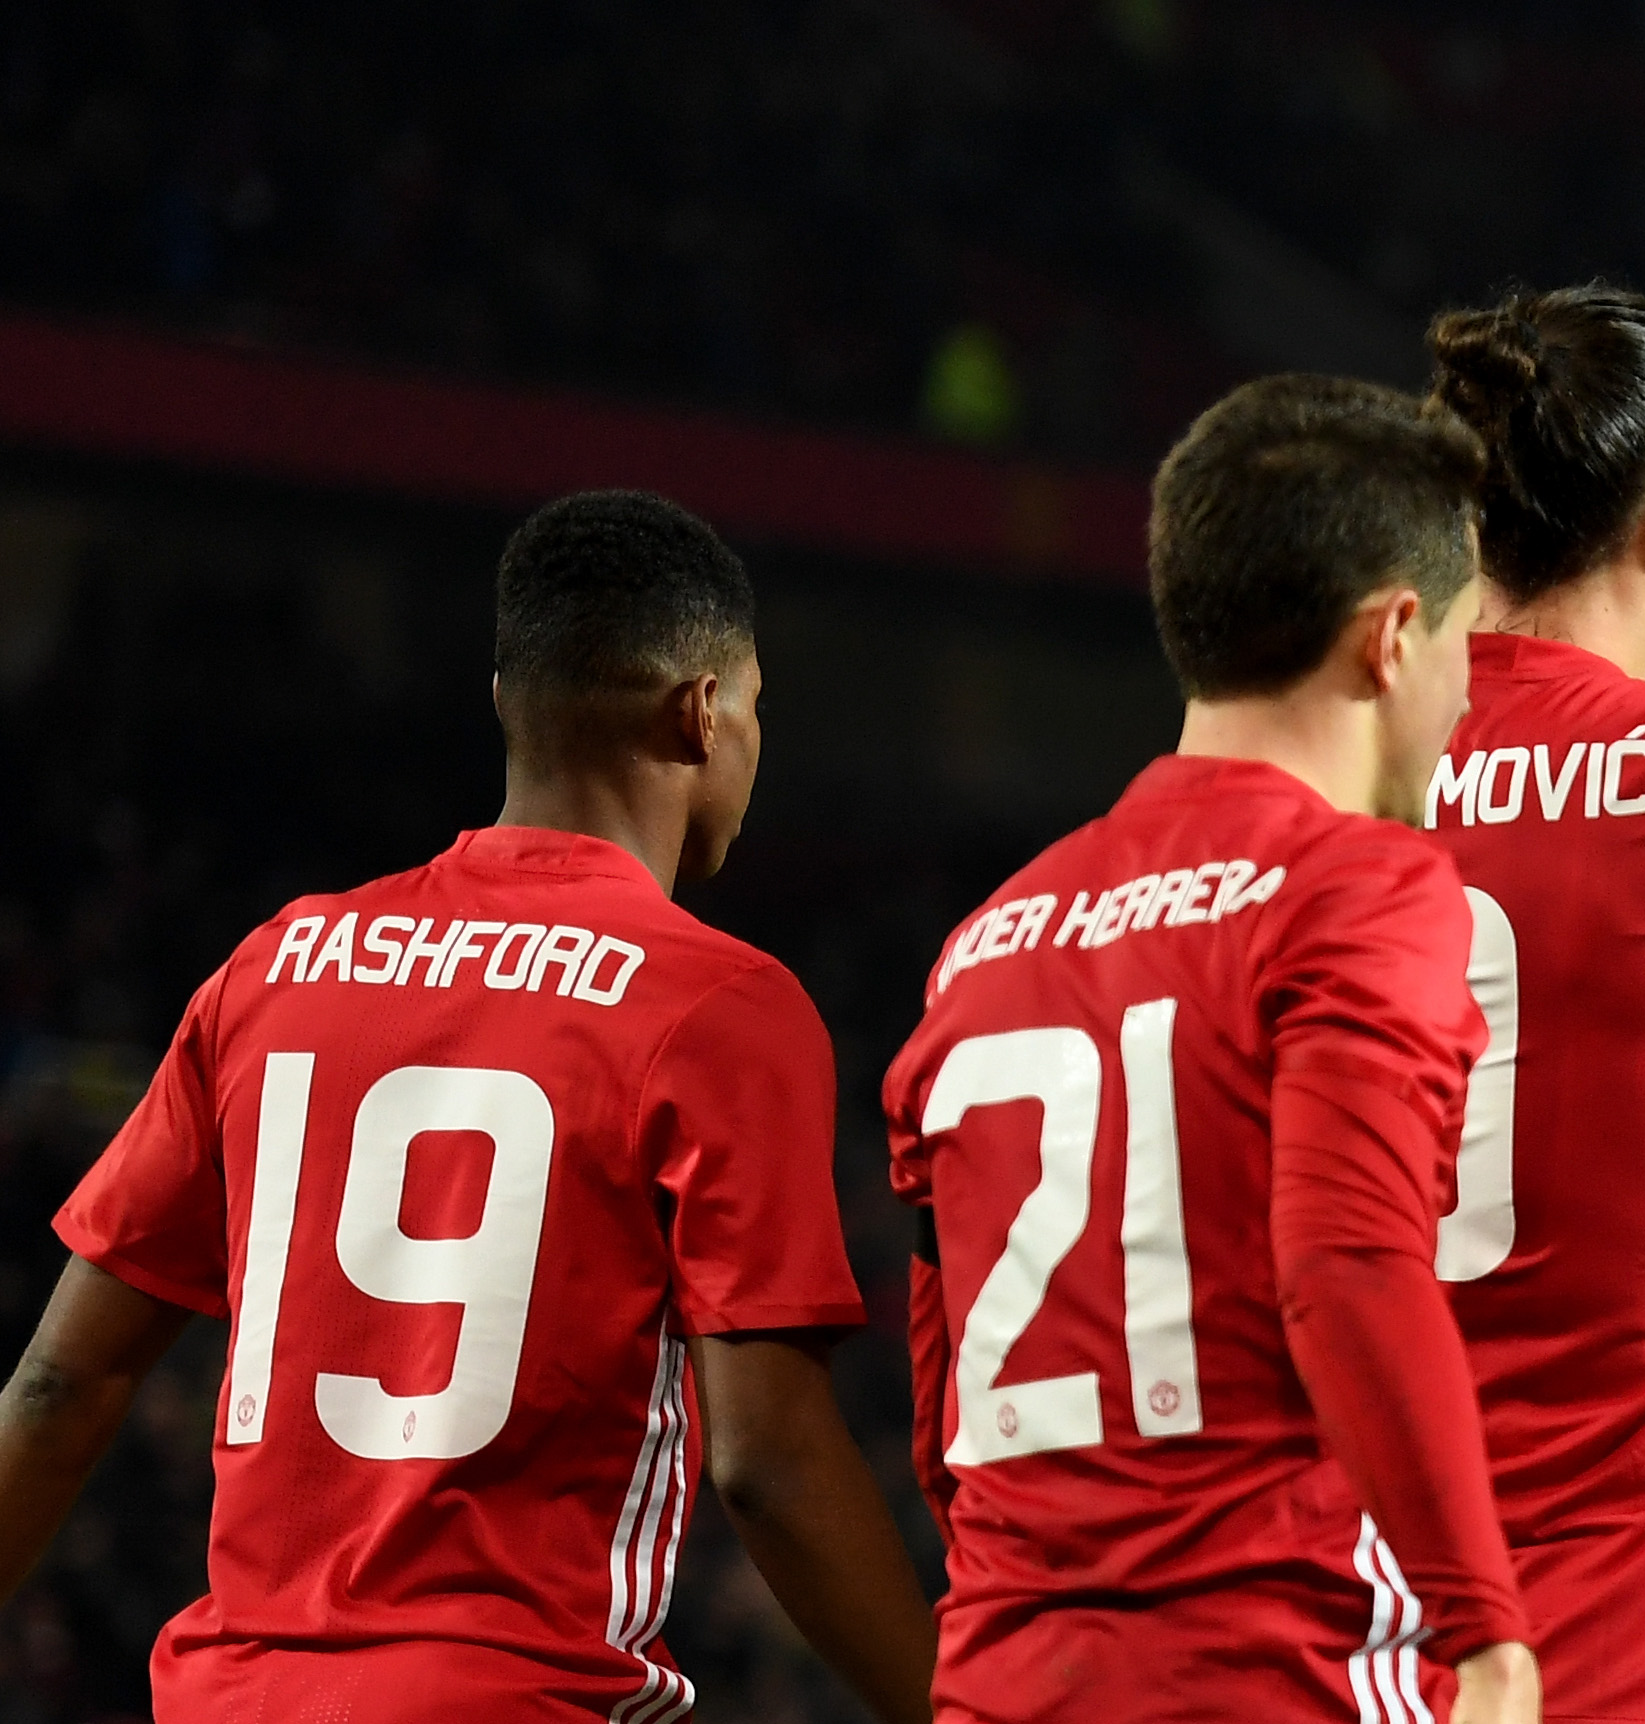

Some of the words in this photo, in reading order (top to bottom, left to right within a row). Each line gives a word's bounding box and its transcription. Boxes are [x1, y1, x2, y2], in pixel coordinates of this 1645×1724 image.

[265, 911, 646, 1006] RASHFORD
[1052, 859, 1287, 949] HERRERA
[226, 1052, 555, 1459] 19
[922, 998, 1202, 1465] 21
